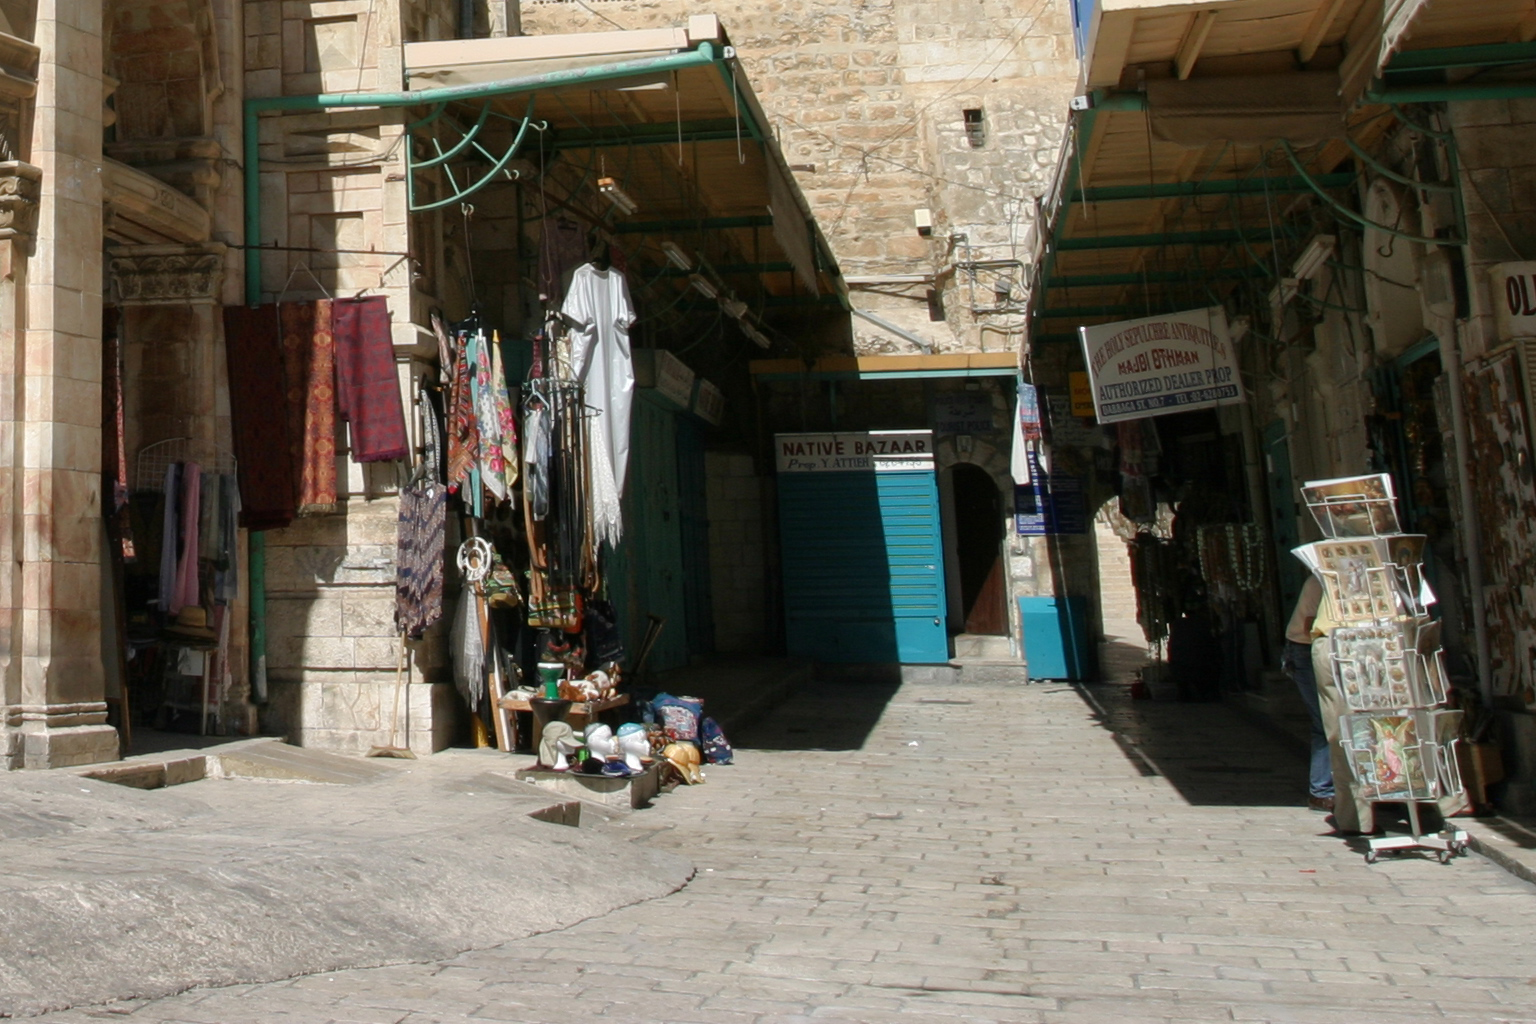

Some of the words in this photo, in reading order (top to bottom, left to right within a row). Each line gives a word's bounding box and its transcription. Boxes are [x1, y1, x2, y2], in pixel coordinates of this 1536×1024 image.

[1506, 274, 1536, 316] OL
[1091, 347, 1106, 379] THE
[1105, 330, 1127, 360] HOLY
[1124, 321, 1172, 350] SEPULCHRE
[1099, 377, 1164, 401] AUTHORIZED
[1165, 371, 1204, 392] DEALER
[1207, 366, 1232, 384] PROP
[782, 440, 845, 457] NATIVE
[854, 439, 926, 455] BAZAAR
